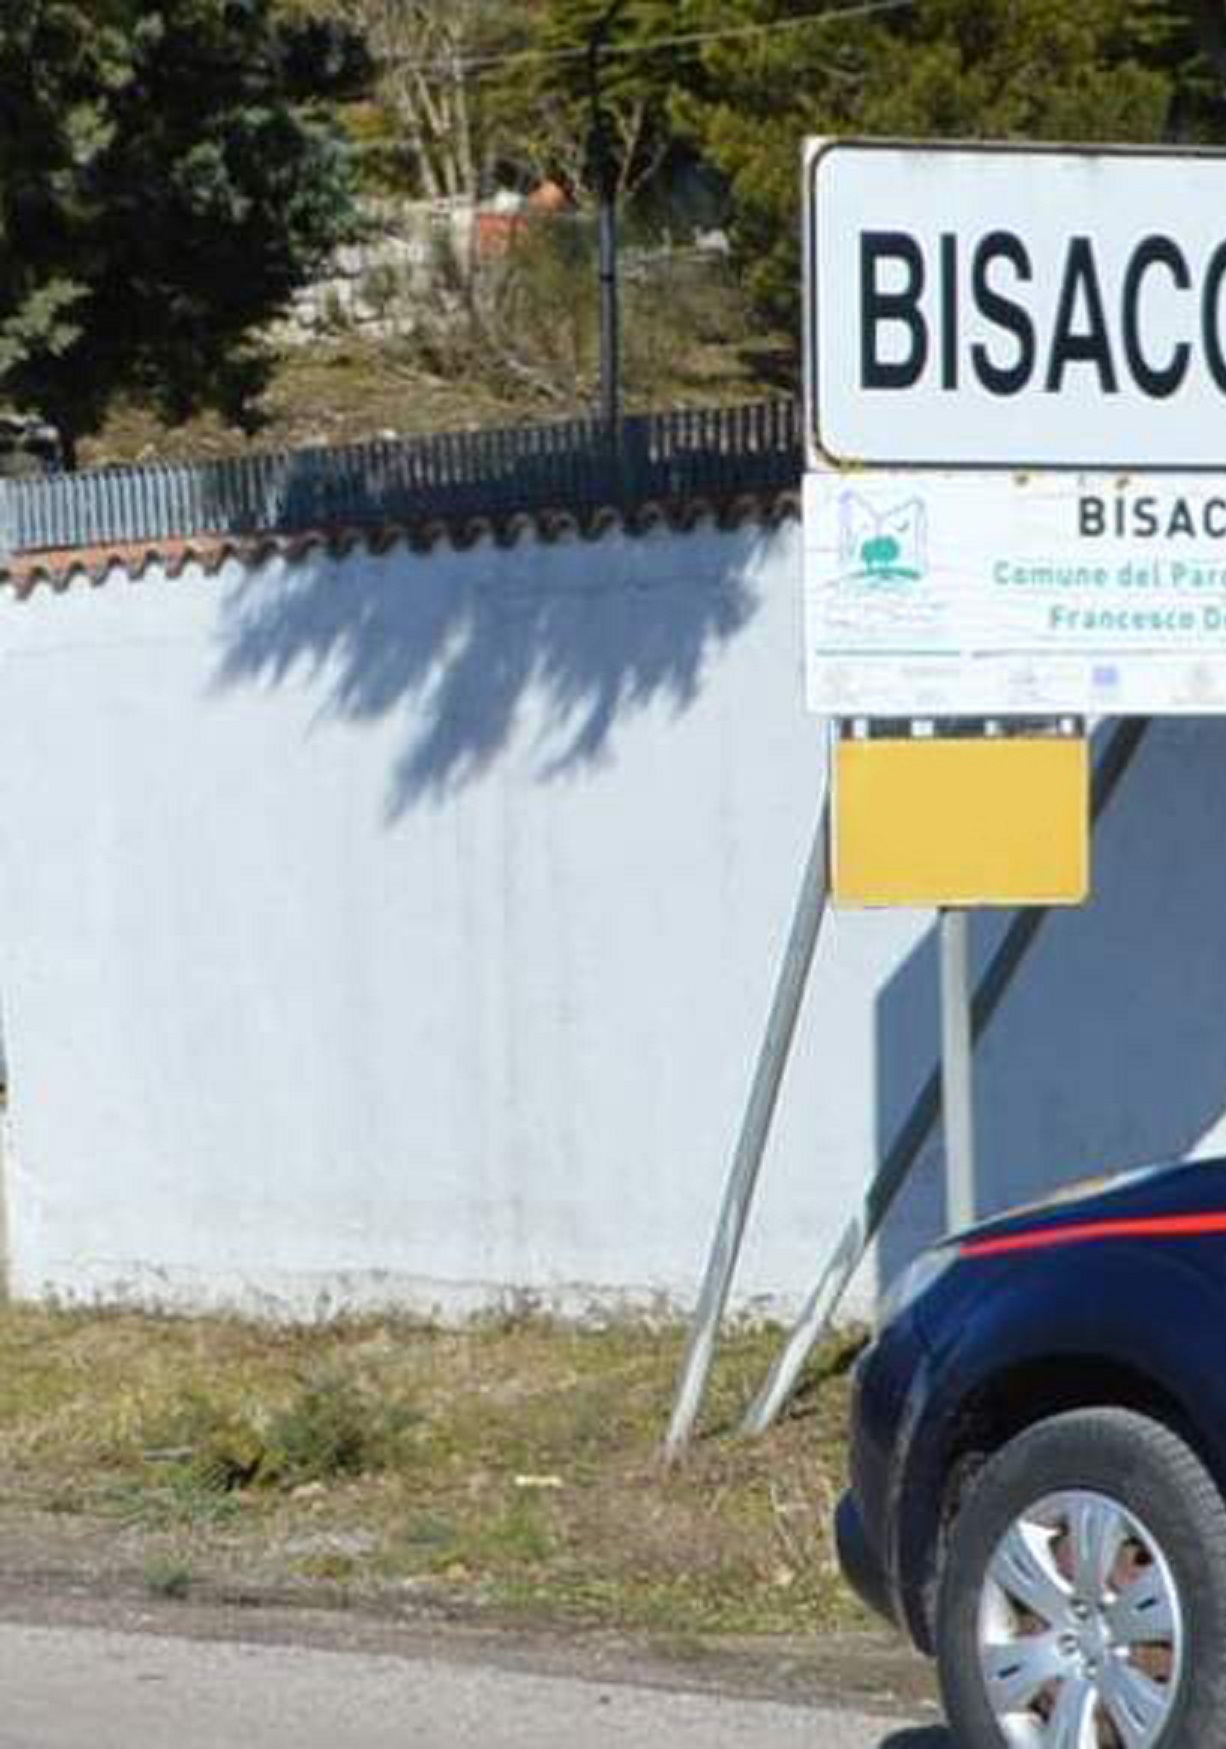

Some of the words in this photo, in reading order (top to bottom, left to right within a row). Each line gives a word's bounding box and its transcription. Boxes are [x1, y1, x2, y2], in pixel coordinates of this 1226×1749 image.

[993, 561, 1108, 587] Comune
[1118, 562, 1161, 588] del
[1050, 605, 1195, 631] Francesco
